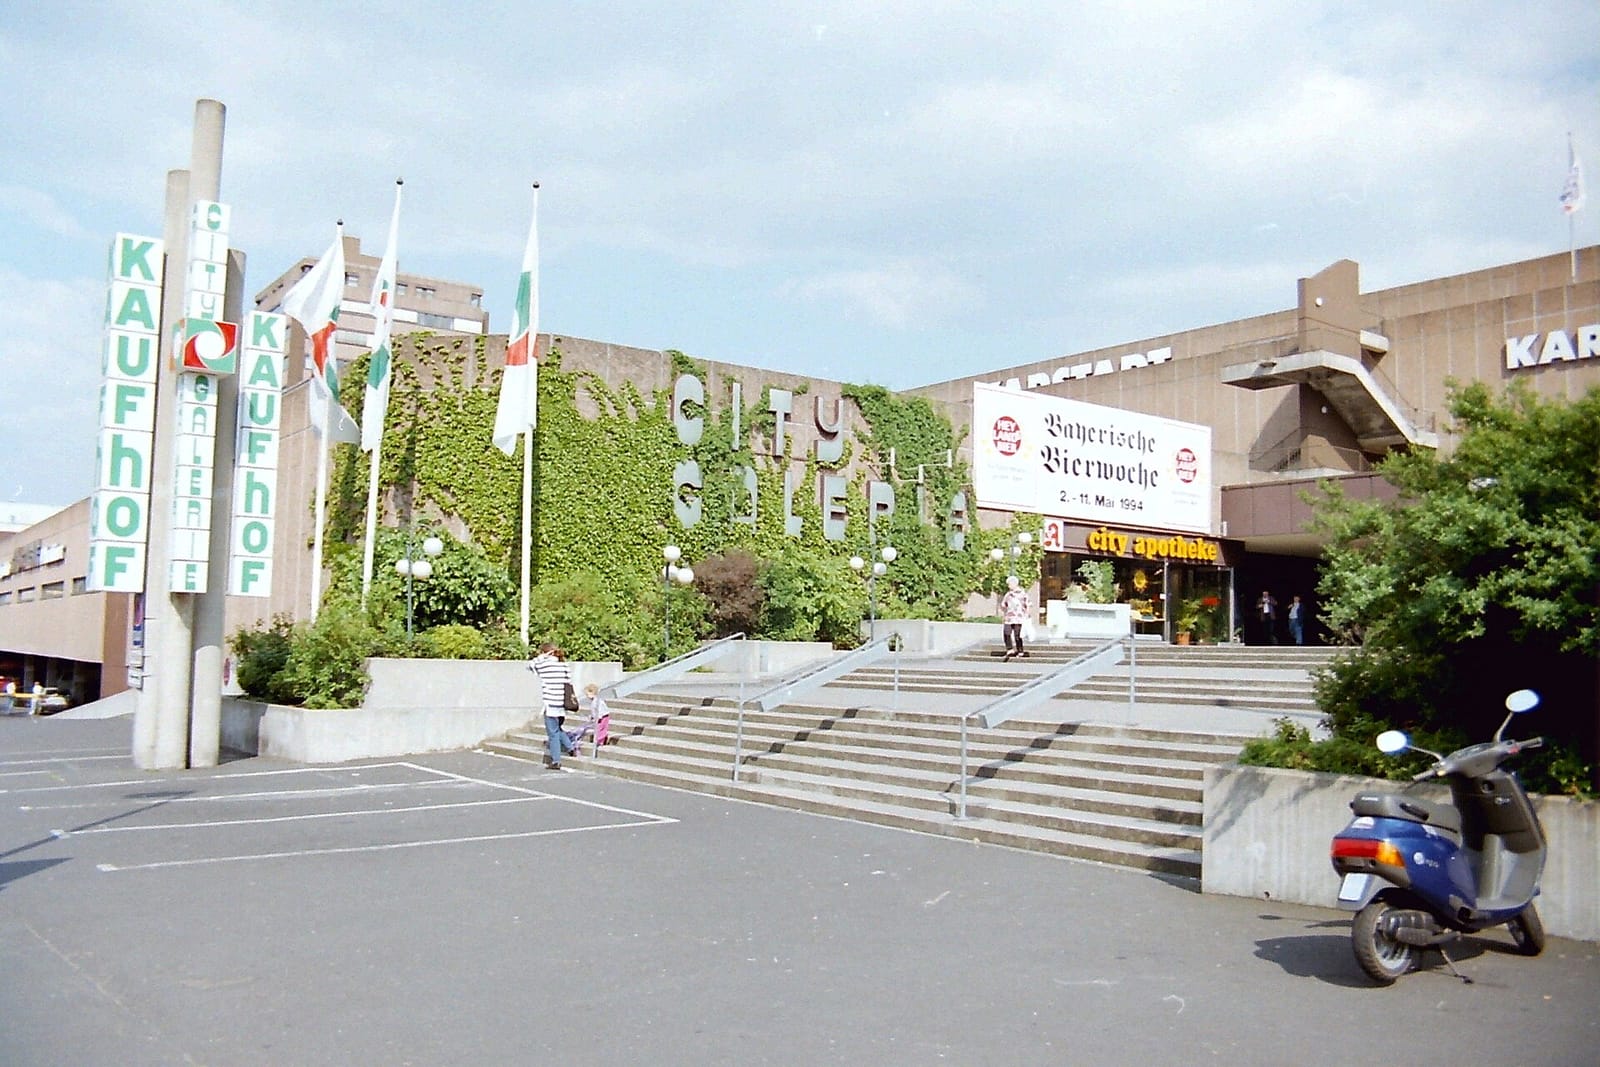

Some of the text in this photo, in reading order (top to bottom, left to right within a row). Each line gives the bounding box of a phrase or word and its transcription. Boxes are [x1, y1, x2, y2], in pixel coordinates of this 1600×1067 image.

[670, 373, 844, 463] CITY
[1044, 413, 1155, 456] Bayerische
[184, 375, 210, 591] GALERIE
[1040, 445, 1159, 491] Bierwoche
[1095, 495, 1115, 508] Mai
[1120, 498, 1143, 511] 1994
[1088, 526, 1219, 562] city apotheke
